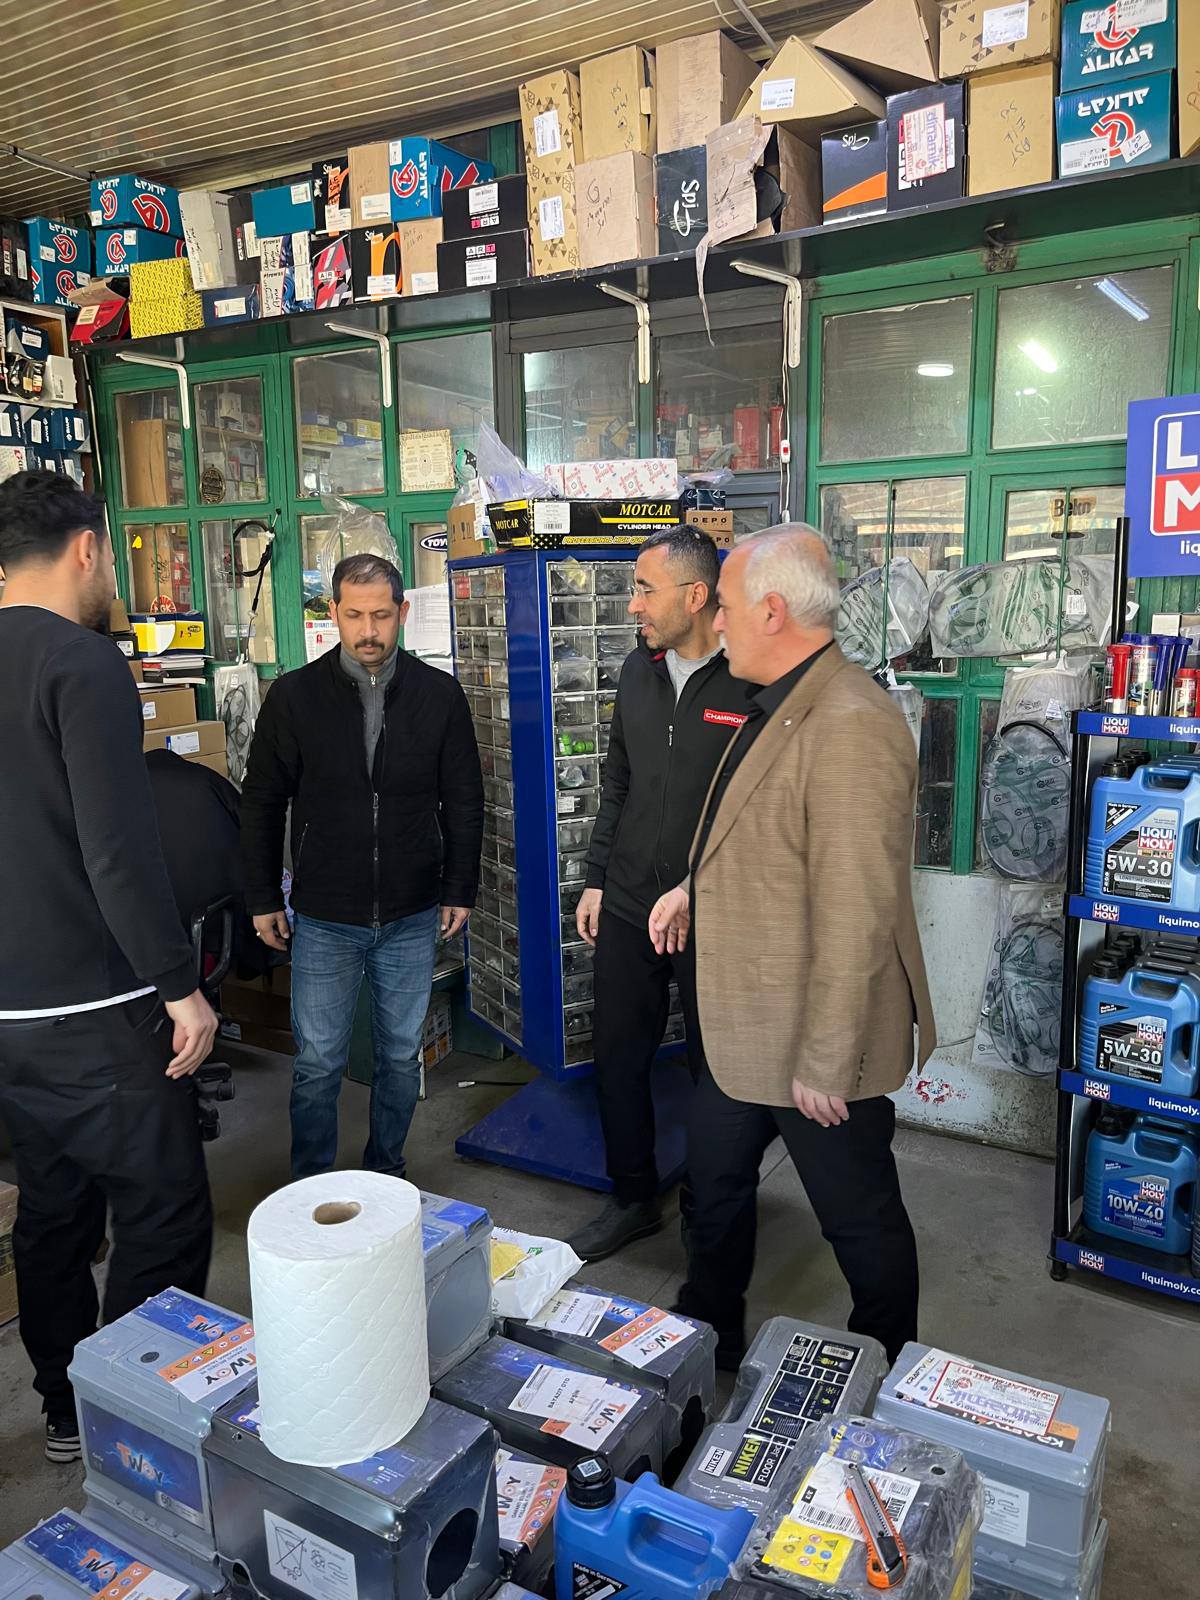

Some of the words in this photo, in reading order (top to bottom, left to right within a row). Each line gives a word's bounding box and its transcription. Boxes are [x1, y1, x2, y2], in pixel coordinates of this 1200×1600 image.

[1081, 44, 1153, 75] ALKAR
[1078, 87, 1149, 117] ALKAR
[419, 151, 429, 199] ALKAR
[97, 178, 120, 190] ALKAR
[134, 179, 166, 196] ALKAR
[472, 215, 499, 229] ART
[49, 223, 78, 237] ALKAR
[466, 244, 496, 256] ART
[105, 264, 130, 274] ALKAR
[319, 270, 344, 280] ART
[620, 504, 672, 516] MOTCAR
[495, 518, 519, 530] MOTCAR
[705, 712, 745, 724] CHAMPION
[1104, 717, 1128, 725] LIQUI
[1103, 724, 1128, 733] MOLY
[1140, 827, 1174, 840] LIQUI
[1139, 837, 1173, 850] MOLY
[1107, 854, 1172, 877] 5W-30
[1094, 903, 1118, 913] LIQUI
[1093, 910, 1118, 920] MOLY
[1139, 1023, 1163, 1034] LIQUI
[1138, 1031, 1163, 1042] MOLY
[1103, 1039, 1162, 1065] 5W-30
[1085, 1080, 1109, 1091] LIQUI
[1085, 1087, 1109, 1098] MOLY
[1142, 1182, 1165, 1192] LIQUI
[1141, 1189, 1165, 1200] MOLY
[1107, 1194, 1164, 1221] 10W-40
[1080, 1250, 1103, 1263] LIQUI
[1080, 1258, 1104, 1270] MOLY
[704, 1448, 725, 1473] NIKEN
[732, 1438, 762, 1476] NIKEN
[757, 1458, 776, 1483] FLOOR
